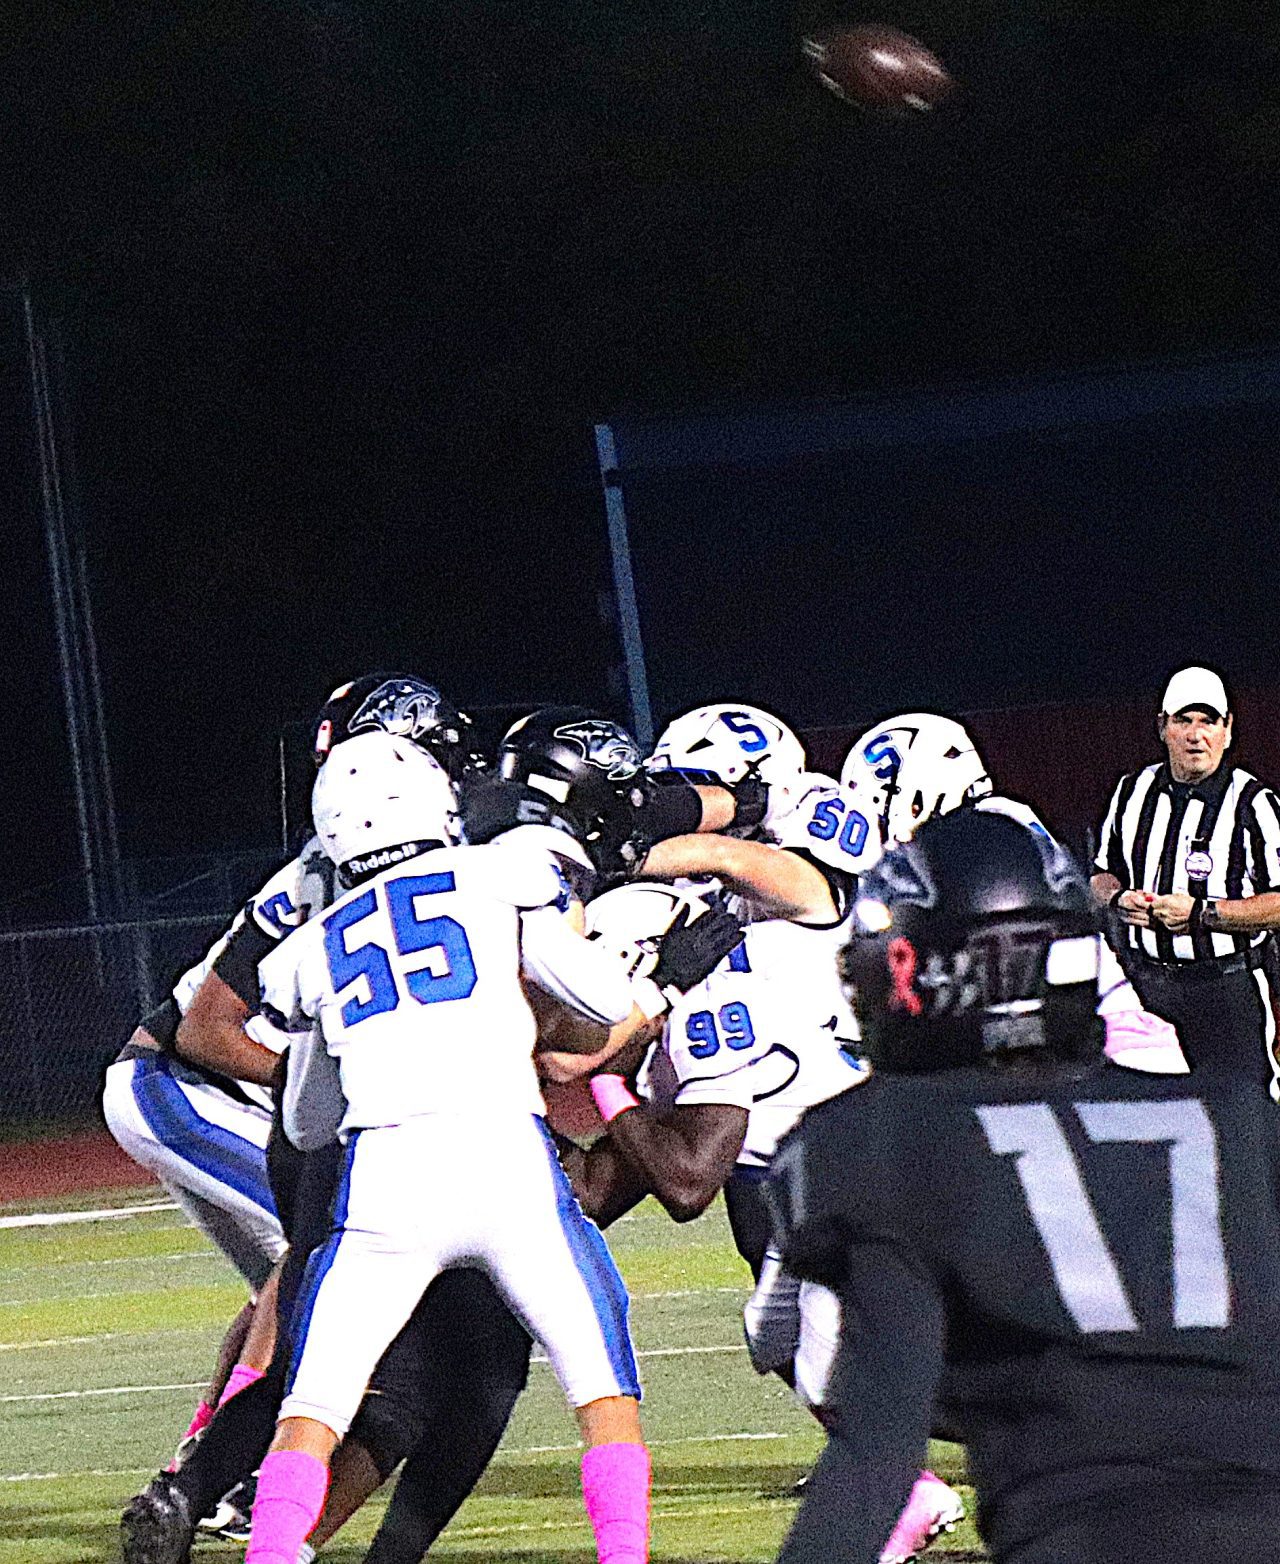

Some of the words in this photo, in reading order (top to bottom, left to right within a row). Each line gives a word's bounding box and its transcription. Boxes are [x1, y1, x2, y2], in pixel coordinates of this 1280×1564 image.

[719, 711, 768, 753] S
[807, 797, 869, 857] 50
[349, 843, 416, 874] Riddell
[322, 871, 477, 1028] 55
[686, 1001, 756, 1059] 99
[973, 1098, 1230, 1334] 17
